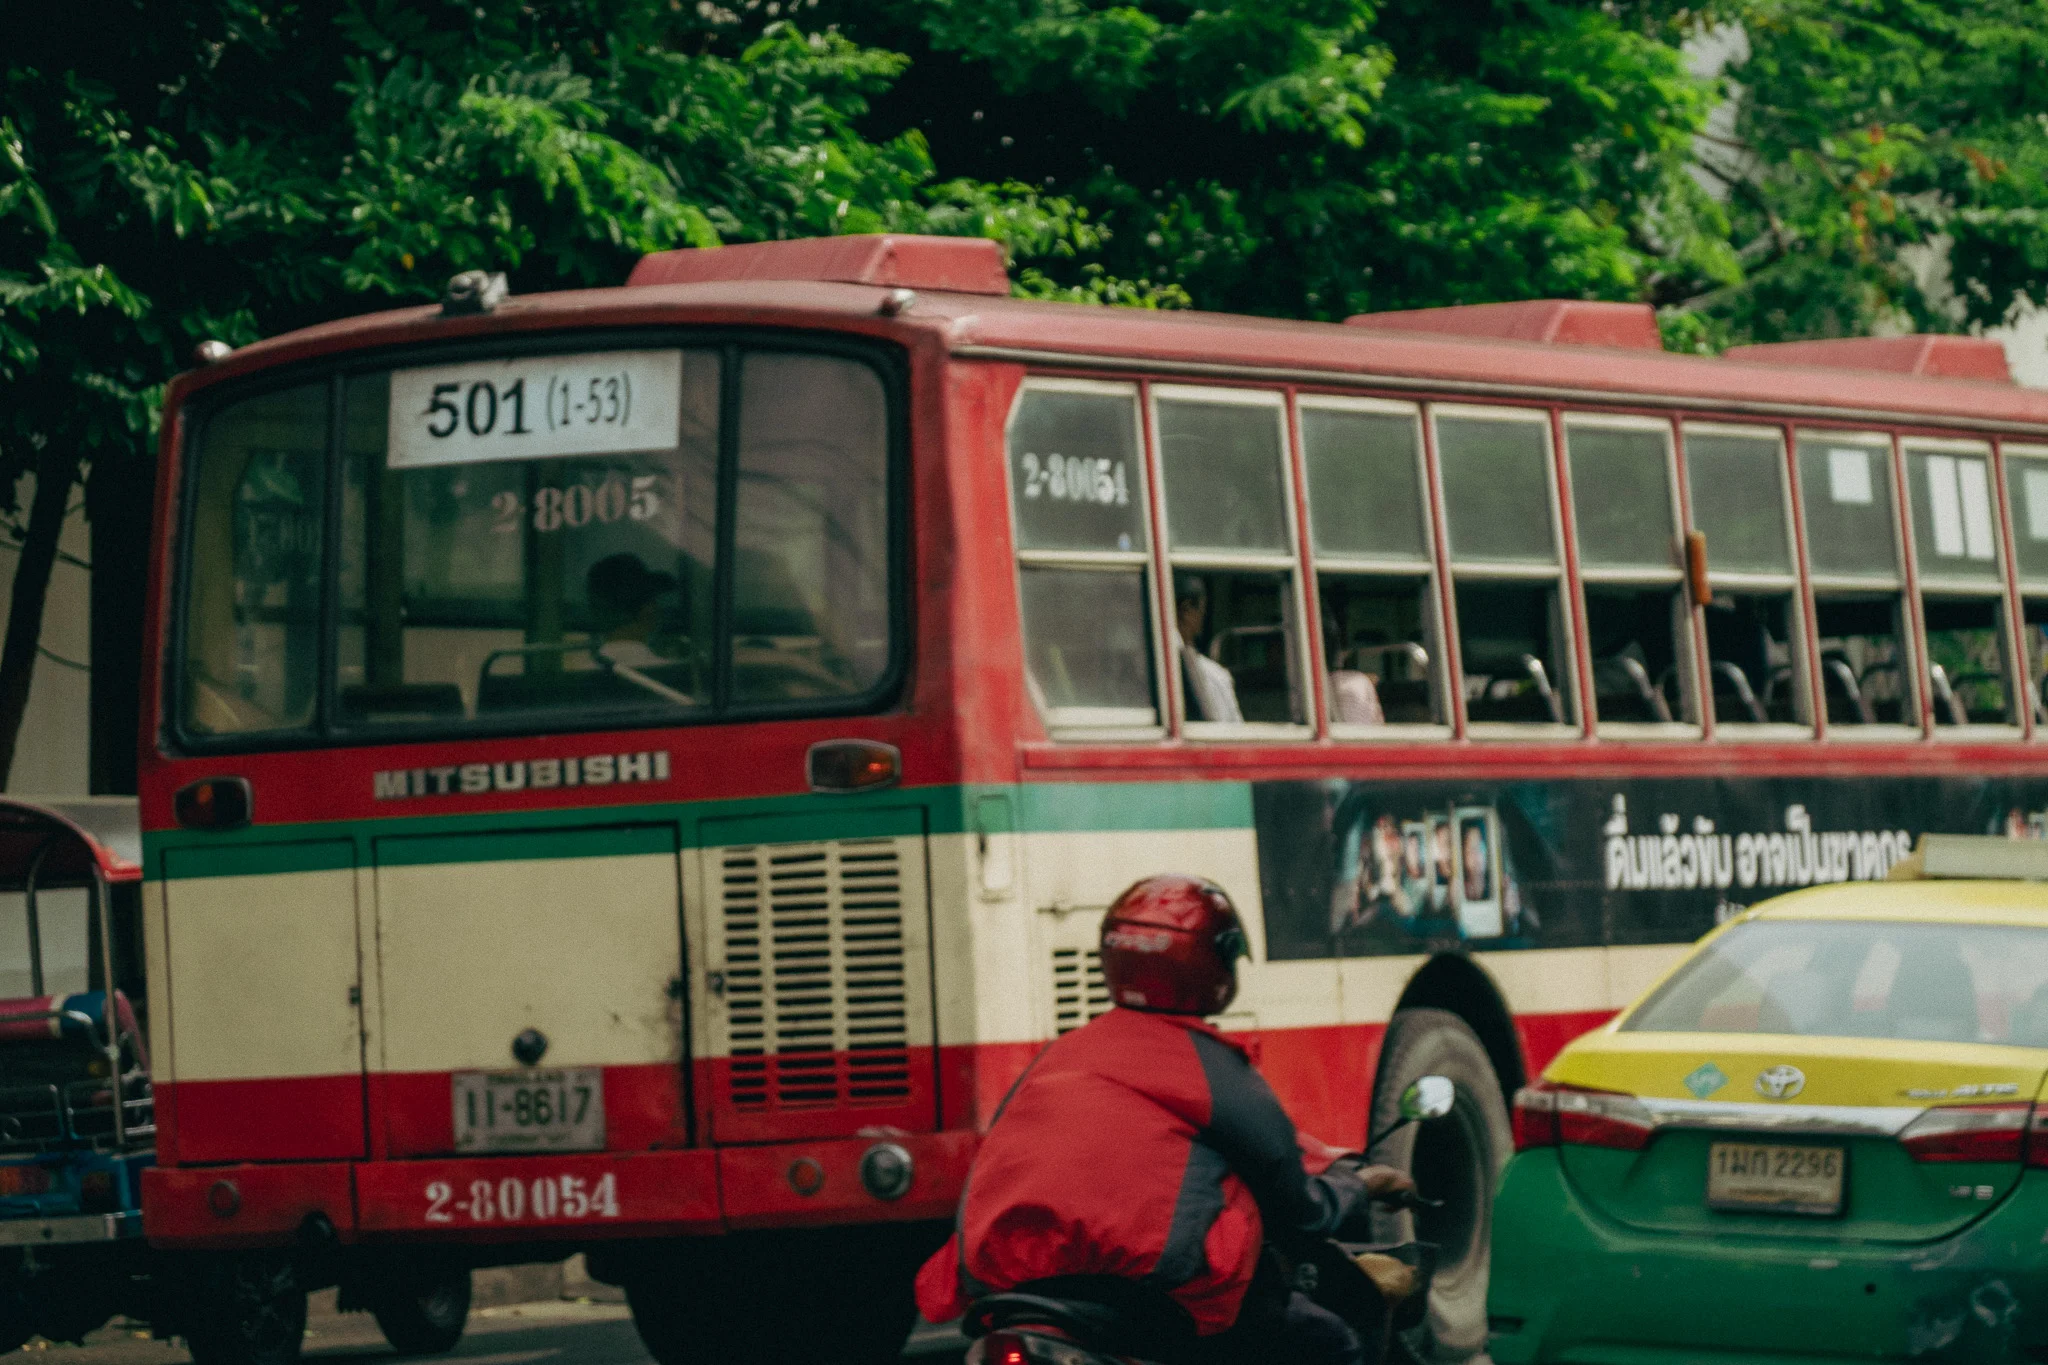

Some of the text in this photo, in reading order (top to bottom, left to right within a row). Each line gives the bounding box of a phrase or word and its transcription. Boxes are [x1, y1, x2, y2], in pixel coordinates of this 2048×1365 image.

[427, 370, 633, 438] 501 (1-53)
[373, 750, 670, 800] MITSUBISHI
[466, 1086, 592, 1127] 11-8617
[1775, 1150, 1837, 1178] 2296
[425, 1172, 620, 1222] 2-80054
